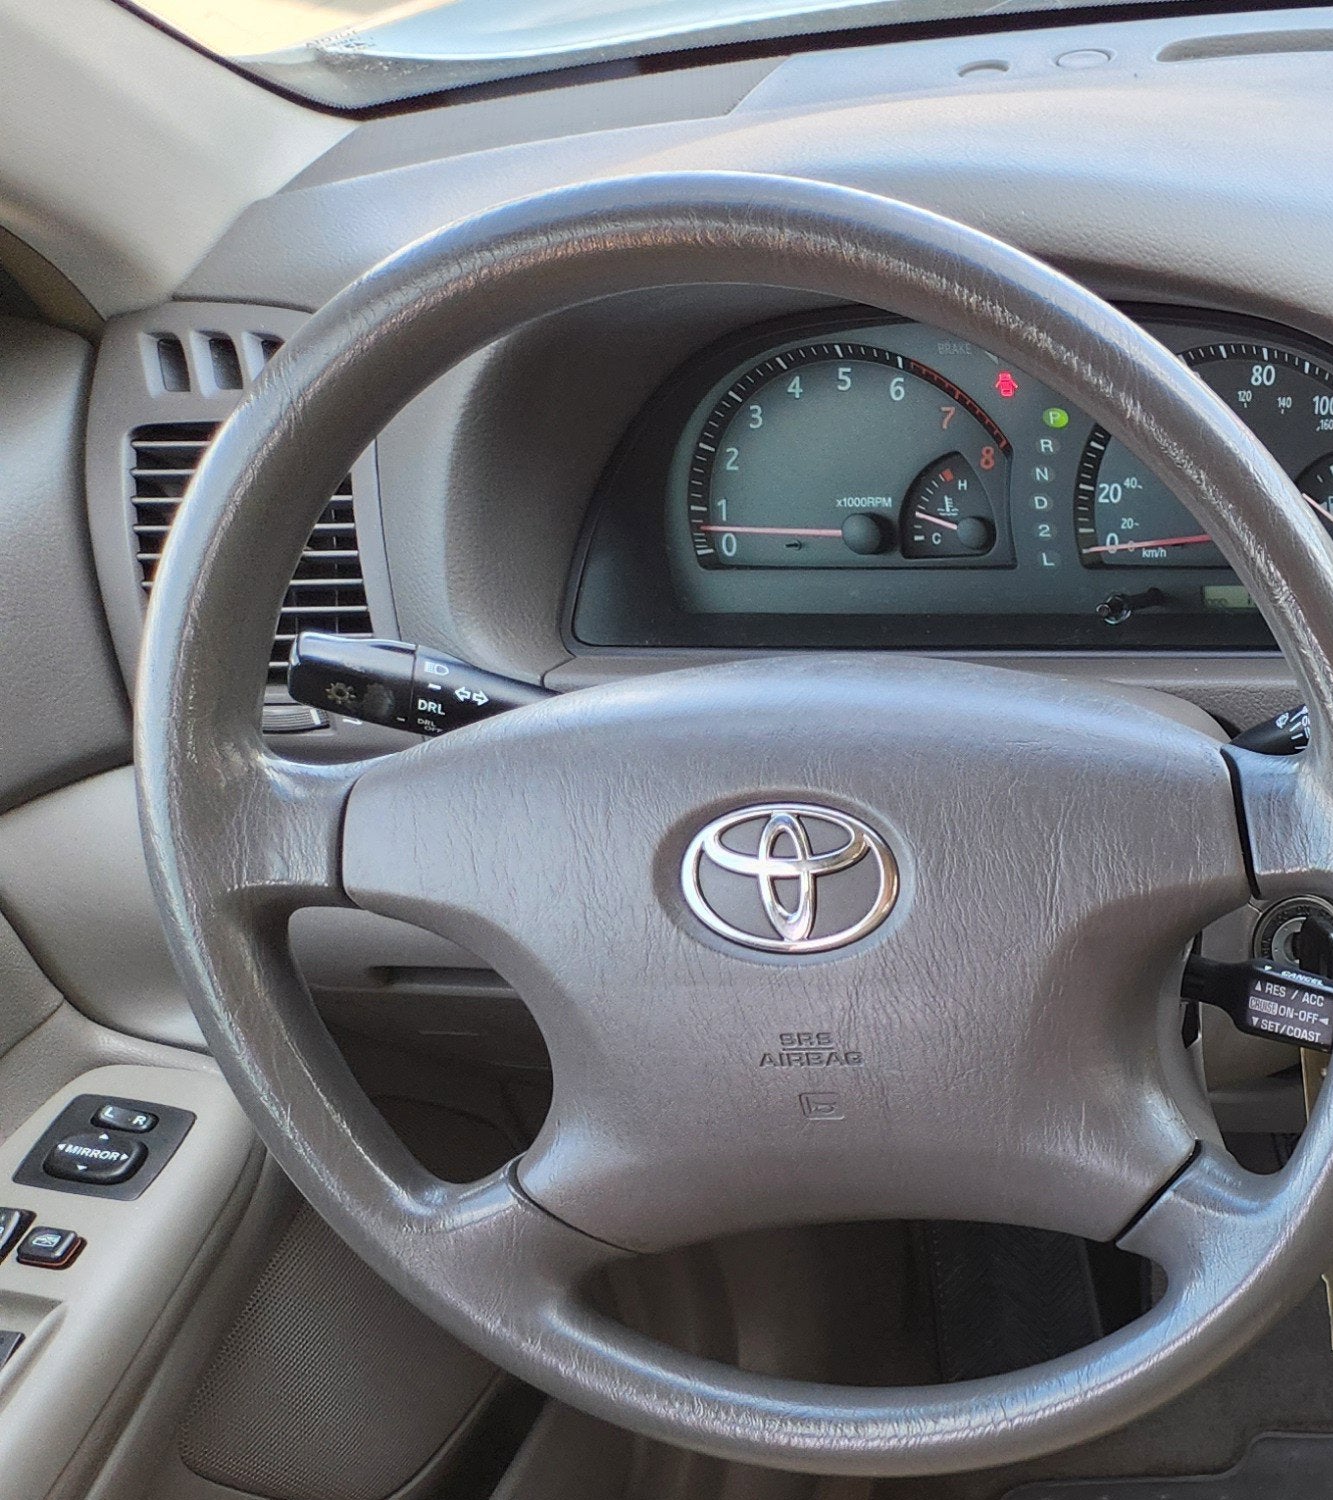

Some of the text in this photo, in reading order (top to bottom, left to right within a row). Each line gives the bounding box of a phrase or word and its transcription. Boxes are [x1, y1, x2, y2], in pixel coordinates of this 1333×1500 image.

[938, 343, 972, 355] BRAKE
[837, 367, 852, 391] 5
[1251, 364, 1276, 387] 80
[787, 376, 803, 398] 4
[889, 377, 905, 401] 6
[1237, 390, 1252, 403] 120
[1277, 396, 1292, 409] 140
[749, 405, 763, 429] 3
[940, 406, 956, 430] 7
[1049, 410, 1062, 425] P
[1040, 439, 1054, 452] R
[725, 447, 739, 471] 2
[980, 446, 995, 470] 8
[1035, 467, 1049, 481] N
[957, 479, 968, 491] H
[1123, 477, 1138, 489] 40
[1098, 483, 1122, 504] 20
[835, 497, 892, 508] x1000RPM
[1034, 496, 1048, 509] D
[717, 499, 728, 522] 1
[1121, 517, 1134, 529] 20
[931, 532, 942, 545] C
[1038, 525, 1051, 537] 2
[721, 532, 737, 557] 0
[1105, 533, 1120, 554] 0
[1042, 553, 1055, 566] L
[1141, 548, 1167, 558] km/h
[418, 698, 445, 715] DRL
[417, 718, 435, 727] DRL
[1281, 970, 1323, 985] CANCEL
[1265, 982, 1286, 998] RES
[1301, 992, 1324, 1007] ACC
[1249, 996, 1319, 1024] CRUISE ON-OFF
[1260, 1019, 1321, 1042] SET/COAST
[780, 1032, 832, 1046] SRS
[759, 1051, 862, 1067] AIRBAG
[104, 1106, 114, 1118] L
[132, 1114, 146, 1126] R
[64, 1144, 120, 1161] MIRROR
